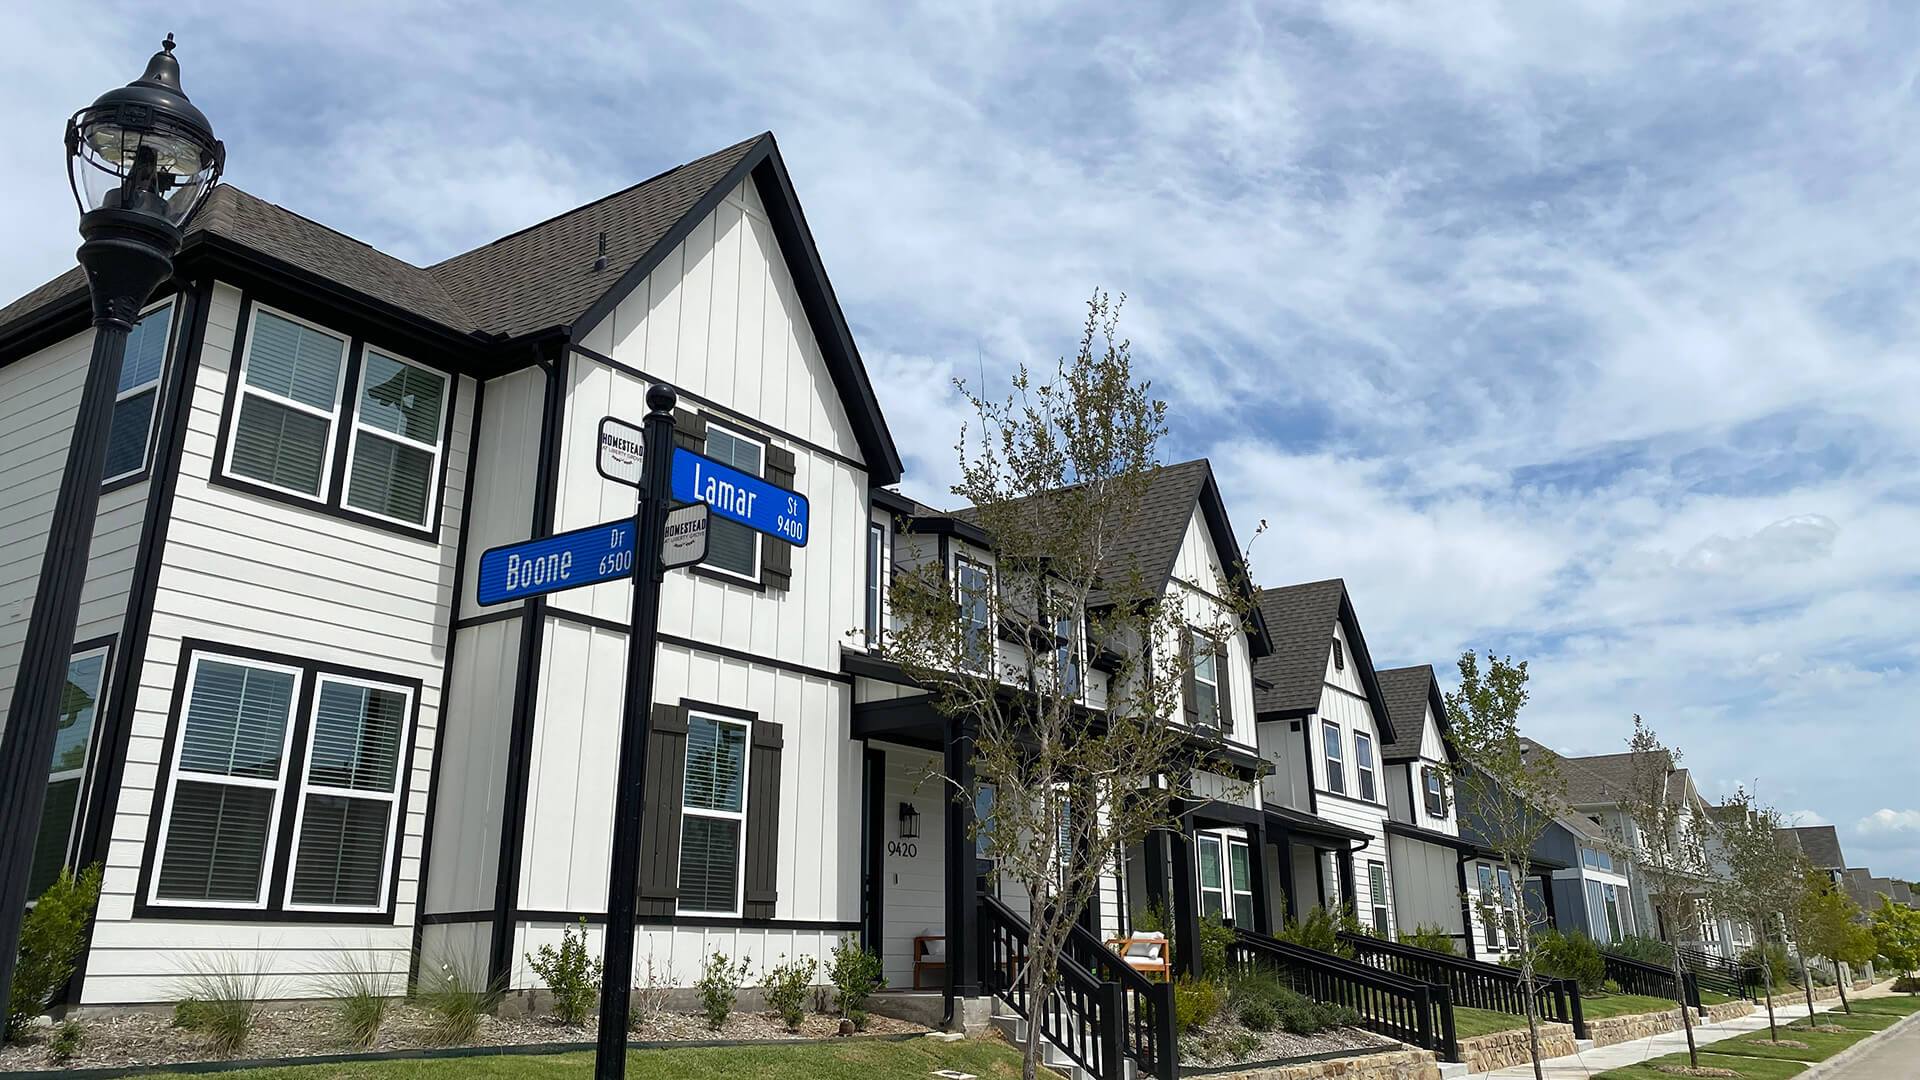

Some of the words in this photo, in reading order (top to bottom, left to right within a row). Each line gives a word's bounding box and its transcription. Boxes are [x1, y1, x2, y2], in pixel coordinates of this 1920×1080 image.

[602, 433, 644, 456] HOMESTEAD
[693, 463, 757, 519] Lamar
[787, 496, 799, 516] St
[664, 518, 706, 538] HOMESTEAD
[777, 515, 803, 540] 9400
[506, 550, 572, 591] Boone
[610, 528, 626, 548] Dr
[599, 550, 632, 575] 6500
[888, 840, 917, 858] 9420
